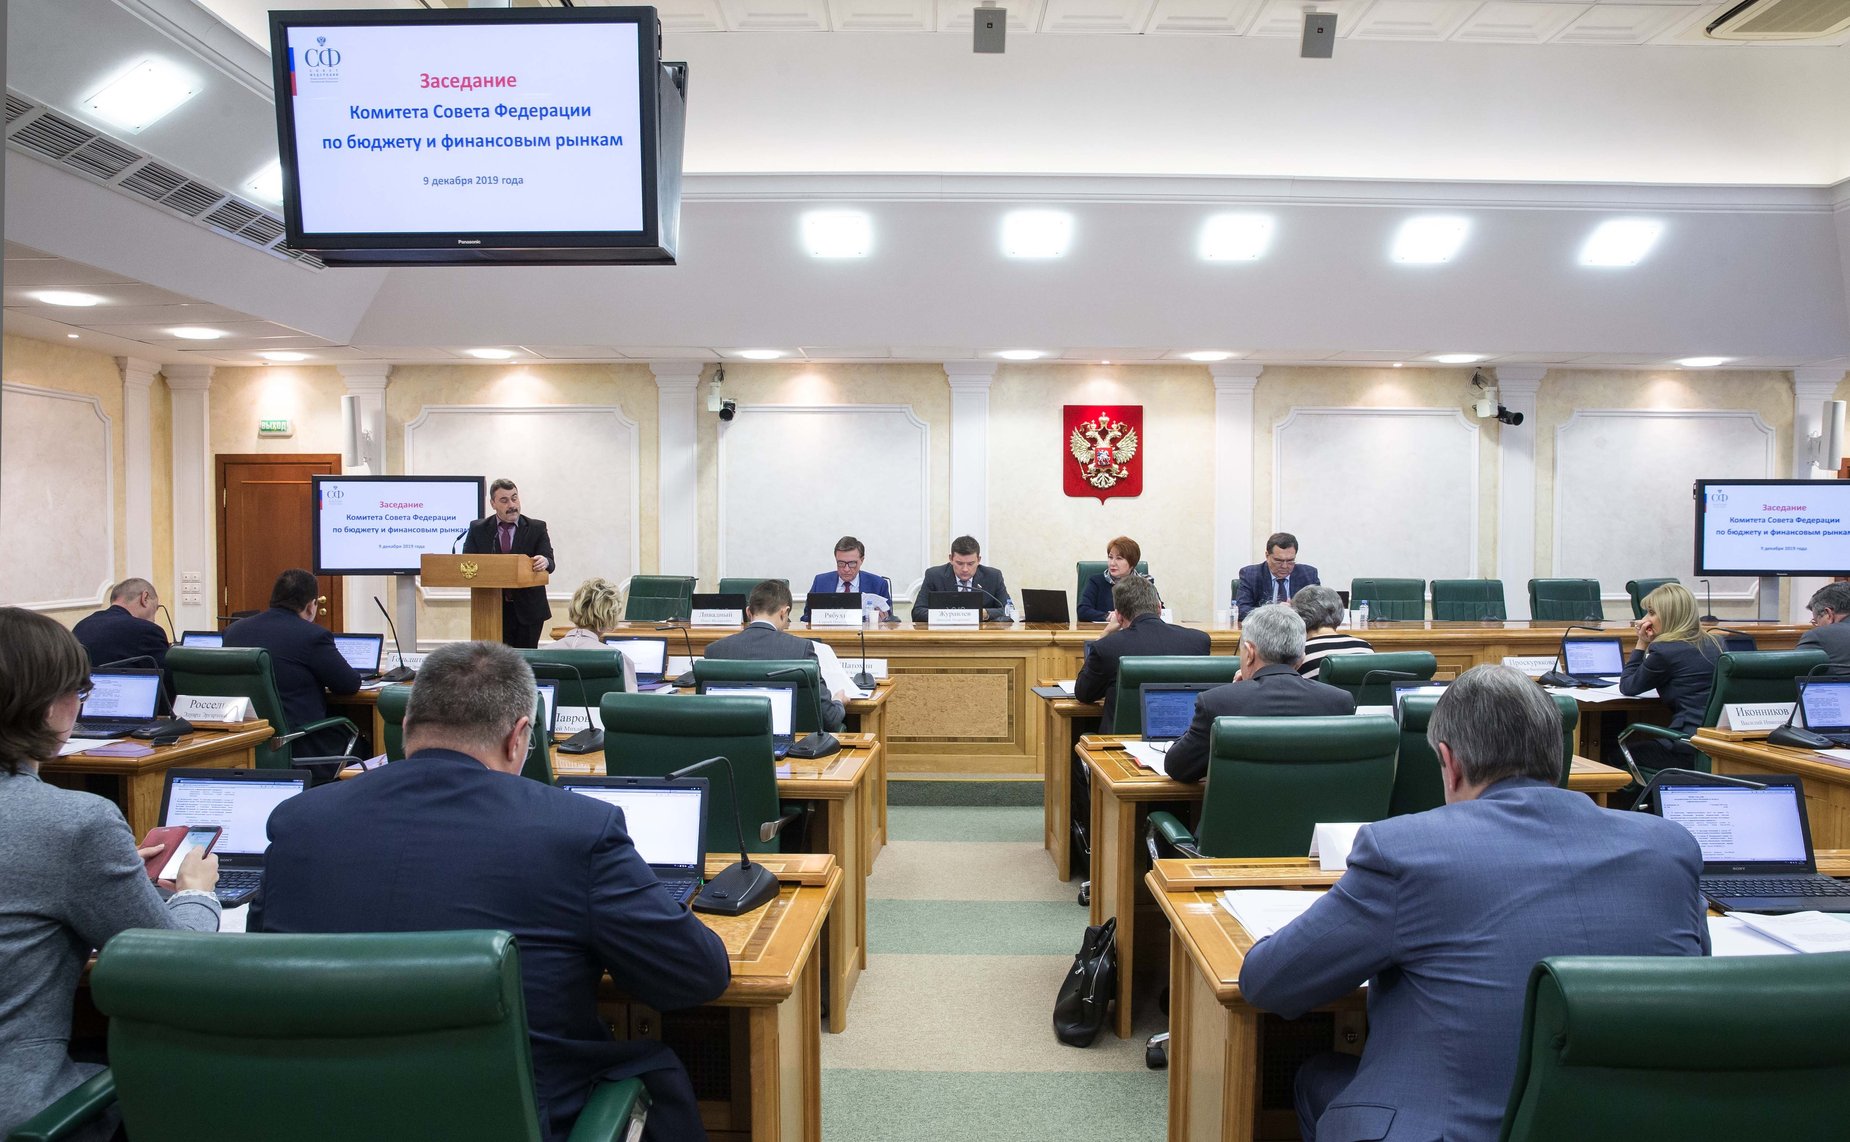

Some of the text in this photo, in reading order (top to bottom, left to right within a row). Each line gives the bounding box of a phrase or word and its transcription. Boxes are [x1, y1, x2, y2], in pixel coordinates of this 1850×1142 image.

[305, 48, 341, 67] СФ
[420, 73, 517, 91] Заседание
[350, 103, 591, 120] Комитета Совета Федерации
[322, 133, 623, 151] по бюджету и финансовым рынкам
[423, 175, 524, 186] 9 декабря 2019 года
[379, 501, 424, 510] Заседание
[1762, 504, 1807, 512] Заседание
[412, 514, 456, 522] Федерации
[1795, 516, 1840, 524] Федерации
[344, 525, 378, 534] бюджету
[387, 525, 438, 534] финансовым
[1727, 528, 1761, 536] бюджету
[1770, 528, 1820, 536] финансовым
[1735, 707, 1790, 717] Иконников
